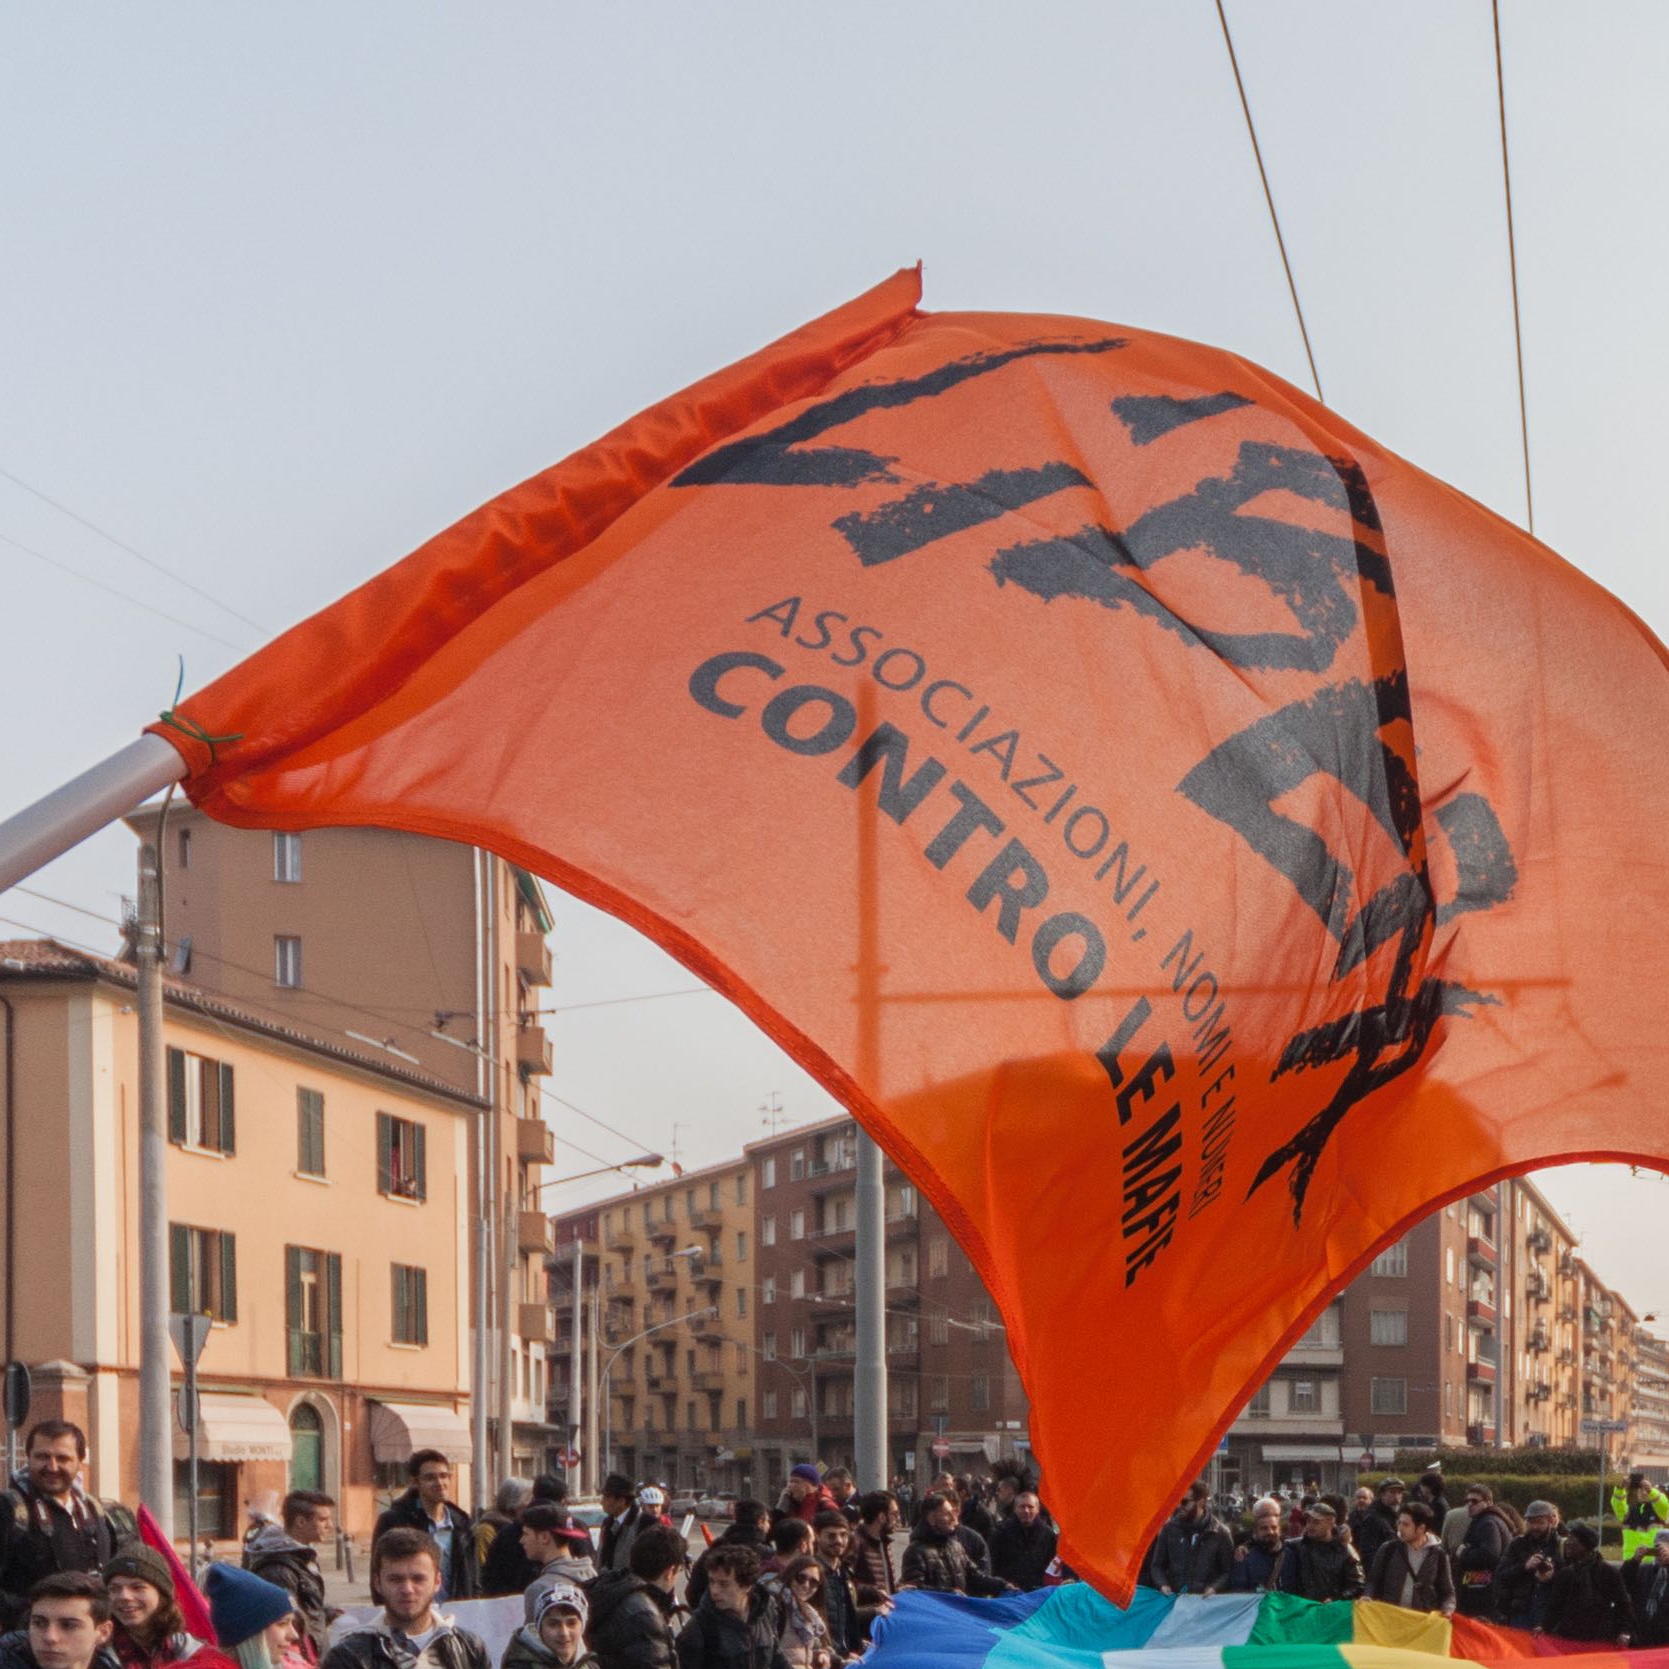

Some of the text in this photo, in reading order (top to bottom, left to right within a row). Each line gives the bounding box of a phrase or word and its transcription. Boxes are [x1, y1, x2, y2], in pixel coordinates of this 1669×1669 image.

[688, 651, 1182, 1289] CONTRO LE MAFIE
[746, 594, 1236, 1220] ASSOCIAZIONI, NOMI E NUMERI
